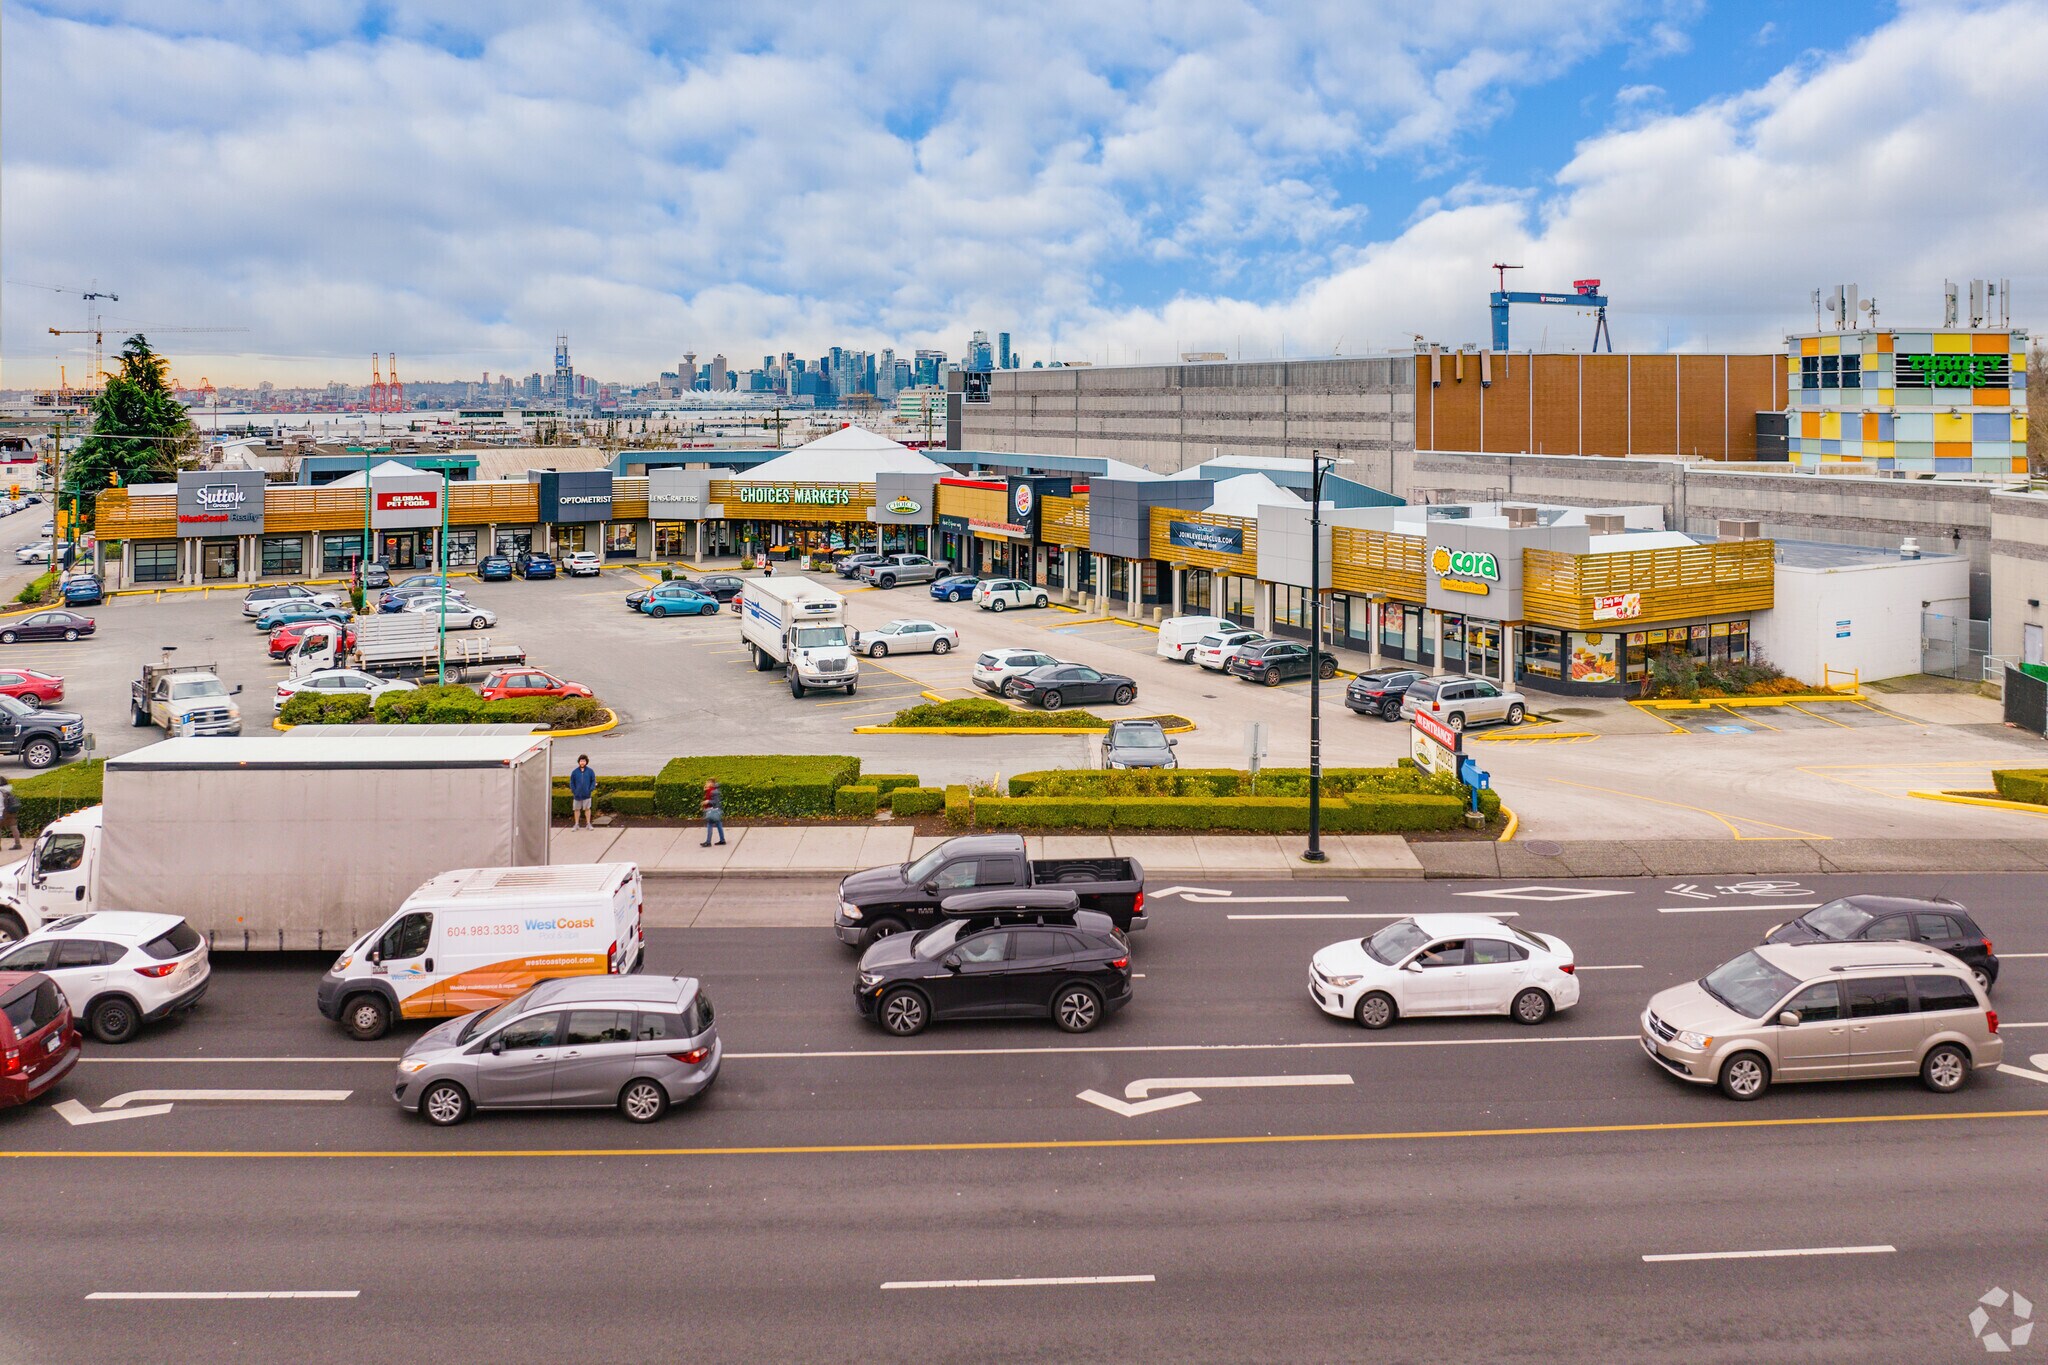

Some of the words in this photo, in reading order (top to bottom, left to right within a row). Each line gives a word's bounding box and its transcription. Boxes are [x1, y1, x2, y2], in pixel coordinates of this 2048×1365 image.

[1908, 355, 2002, 370] THRIFTY
[1924, 371, 1986, 386] FOODS
[196, 487, 246, 504] Sutton
[559, 495, 612, 505] OPTOMETRIST
[740, 487, 790, 503] CHOICES
[794, 488, 849, 505] MARKETS
[1018, 497, 1029, 507] KING
[888, 501, 920, 510] CHOICES
[178, 513, 229, 523] WestCoast
[231, 512, 258, 523] Realty
[1179, 532, 1233, 544] JOINLEVELUPCLUB.COM
[1451, 552, 1497, 578] cora
[1422, 717, 1453, 746] ENTRANCE
[1436, 745, 1453, 769] CHOICES
[447, 924, 519, 937] 604.983.3333
[525, 917, 595, 930] WestCoast
[525, 956, 595, 967] westcoastpool.com
